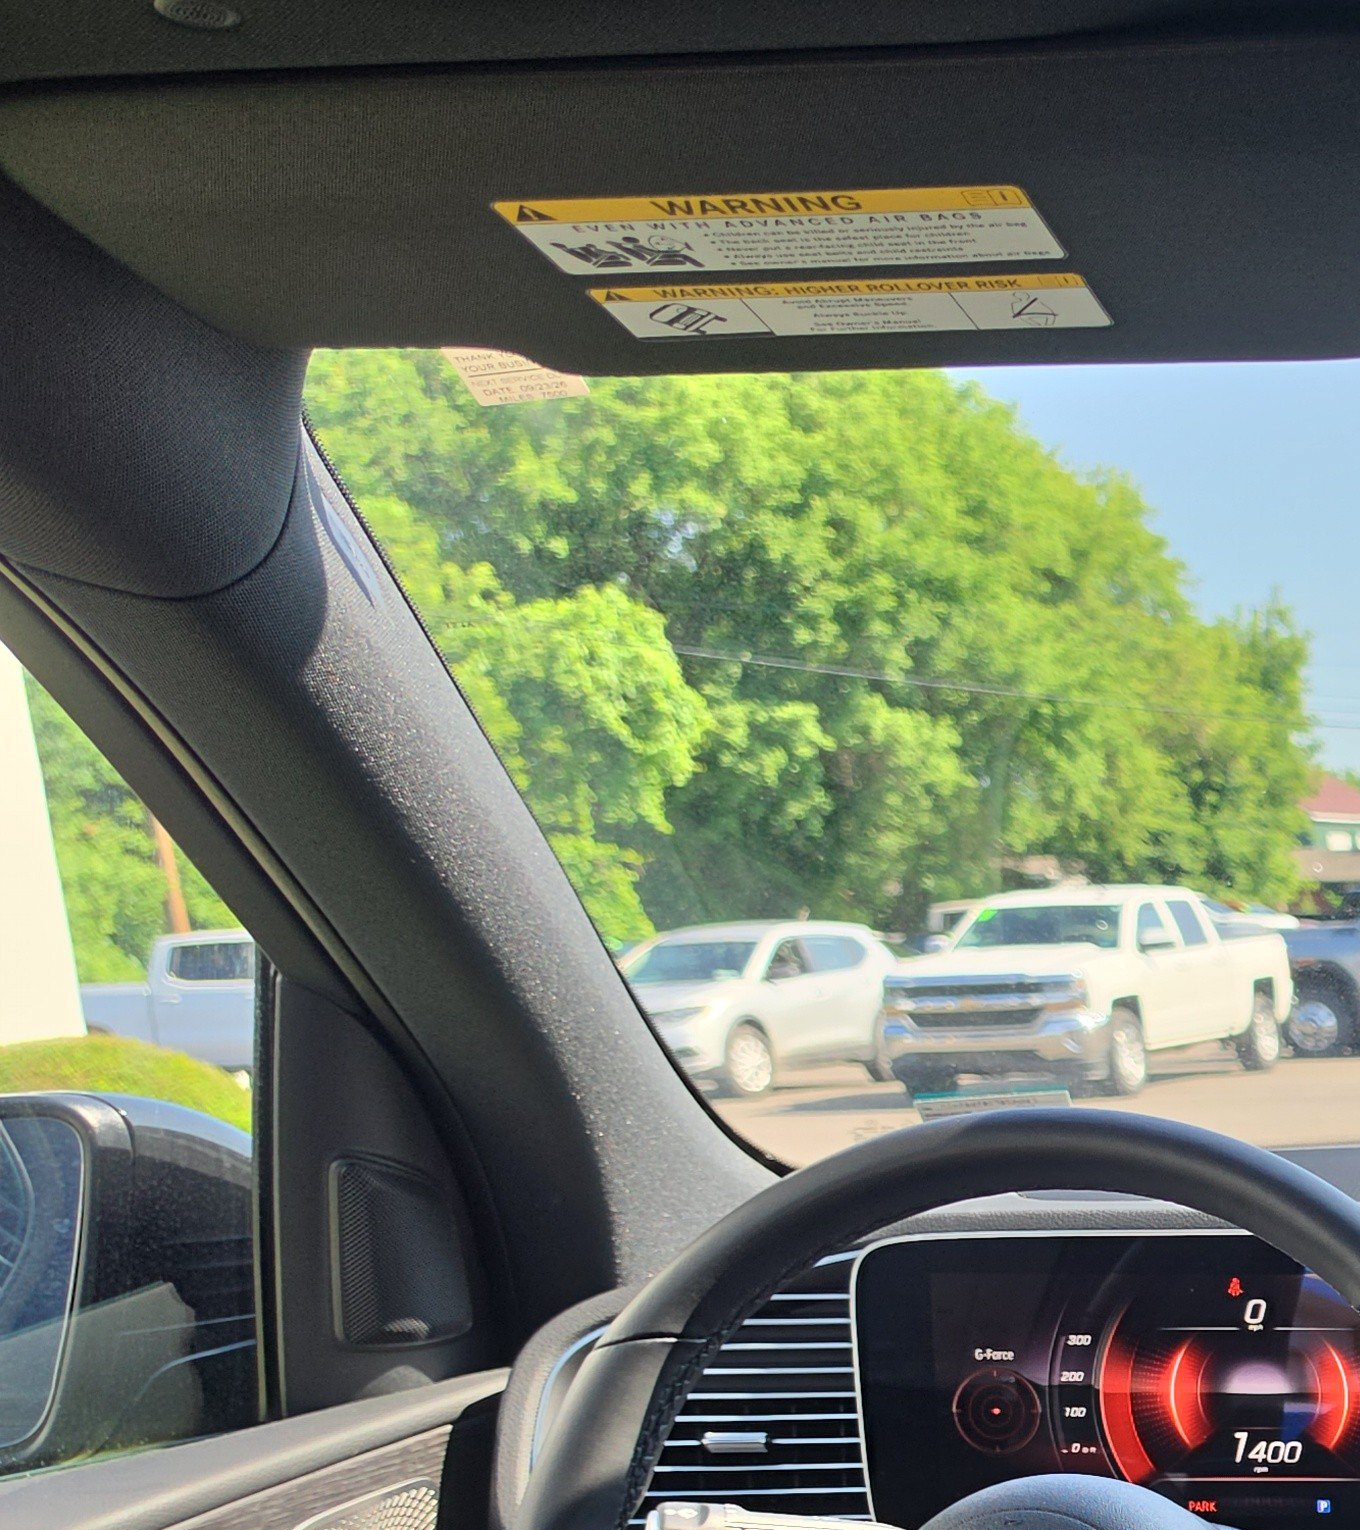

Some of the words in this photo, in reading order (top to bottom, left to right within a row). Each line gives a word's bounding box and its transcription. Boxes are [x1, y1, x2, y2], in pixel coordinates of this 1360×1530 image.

[650, 194, 863, 216] WARNING
[572, 224, 635, 233] EVEN
[646, 220, 710, 231] WITH
[725, 216, 854, 228] ADVANCED
[868, 213, 907, 224] AIR
[920, 212, 982, 222] BAGS
[653, 286, 779, 299] WARNING:
[784, 284, 860, 295] HIGHER
[867, 280, 974, 292] ROLLOVER
[975, 278, 1022, 289] RISK
[454, 352, 494, 363] THANK
[461, 362, 495, 373] YOUR
[483, 386, 514, 397] DATE
[1243, 1299, 1267, 1325] 0
[1066, 1334, 1092, 1346] 300
[974, 1348, 1015, 1361] G-Force
[1061, 1371, 1085, 1382] 200
[1063, 1406, 1087, 1418] 100
[1234, 1431, 1302, 1463] 1400
[1188, 1501, 1218, 1513] PARK
